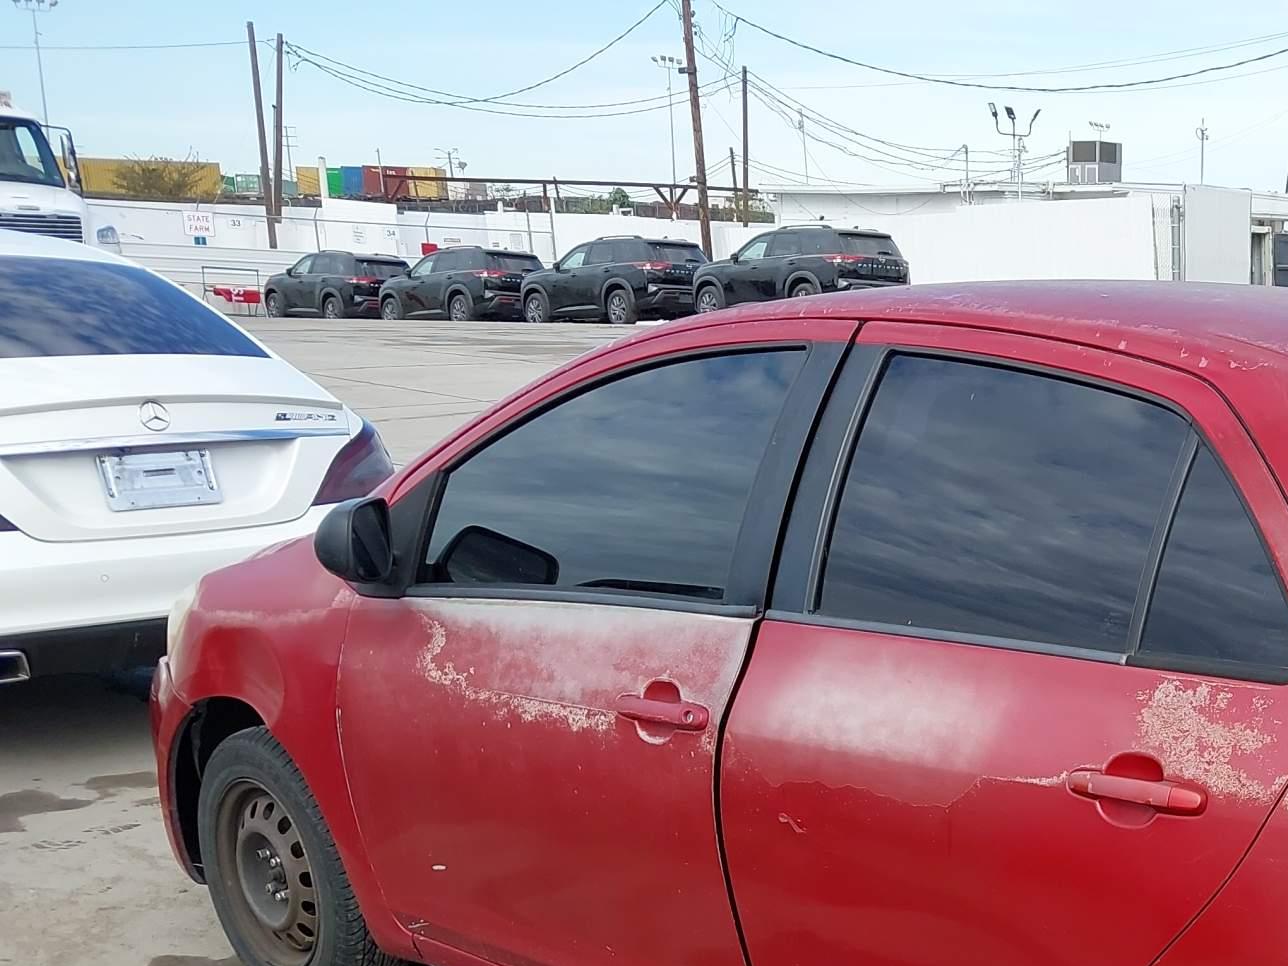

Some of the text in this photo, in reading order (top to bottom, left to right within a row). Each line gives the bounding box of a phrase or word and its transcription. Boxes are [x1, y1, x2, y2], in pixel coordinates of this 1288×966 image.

[187, 214, 210, 223] STATE
[231, 219, 241, 227] 33
[189, 224, 210, 233] FARM
[386, 229, 396, 237] 34
